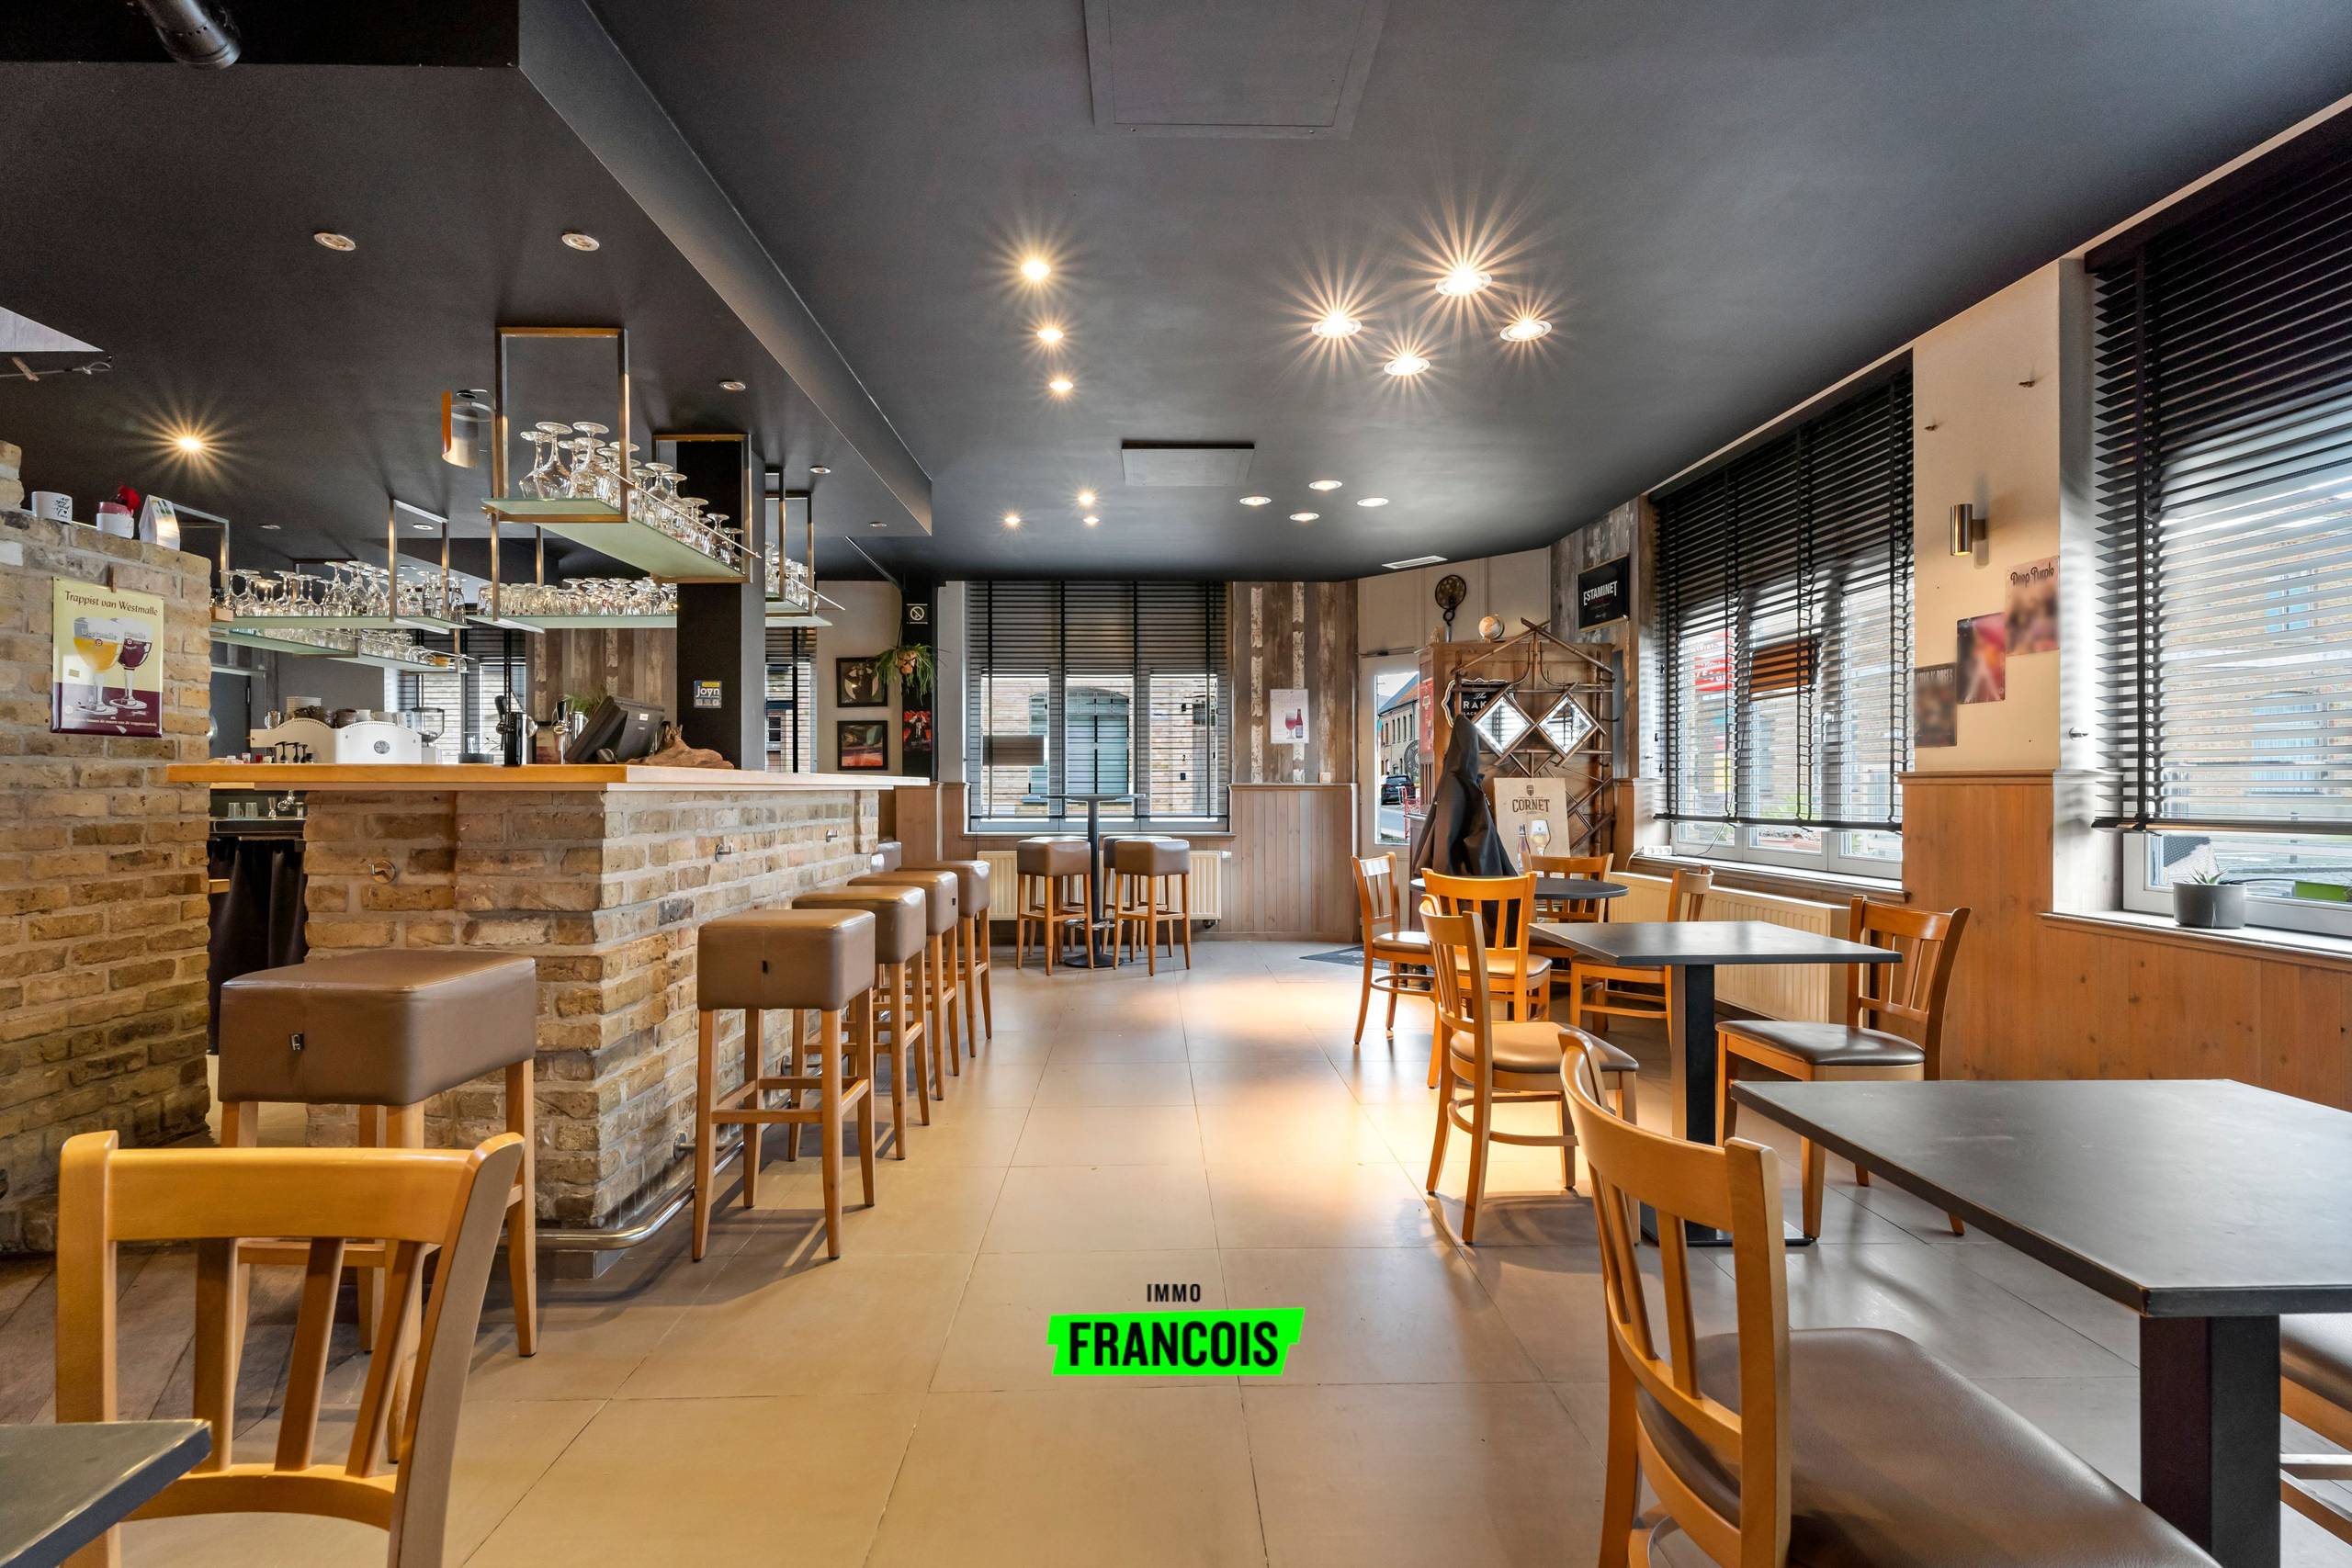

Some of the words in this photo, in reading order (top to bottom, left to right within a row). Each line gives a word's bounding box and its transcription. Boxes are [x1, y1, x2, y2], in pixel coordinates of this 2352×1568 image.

[2010, 571, 2030, 588] Deep
[2030, 561, 2054, 581] Purple
[64, 591, 99, 605] Trappist
[101, 600, 117, 609] van
[119, 600, 158, 616] Westmalle
[1583, 580, 1618, 607] ESTAMINET
[695, 685, 720, 698] joyn
[1463, 700, 1487, 709] RAK
[1512, 798, 1551, 813] CORNET
